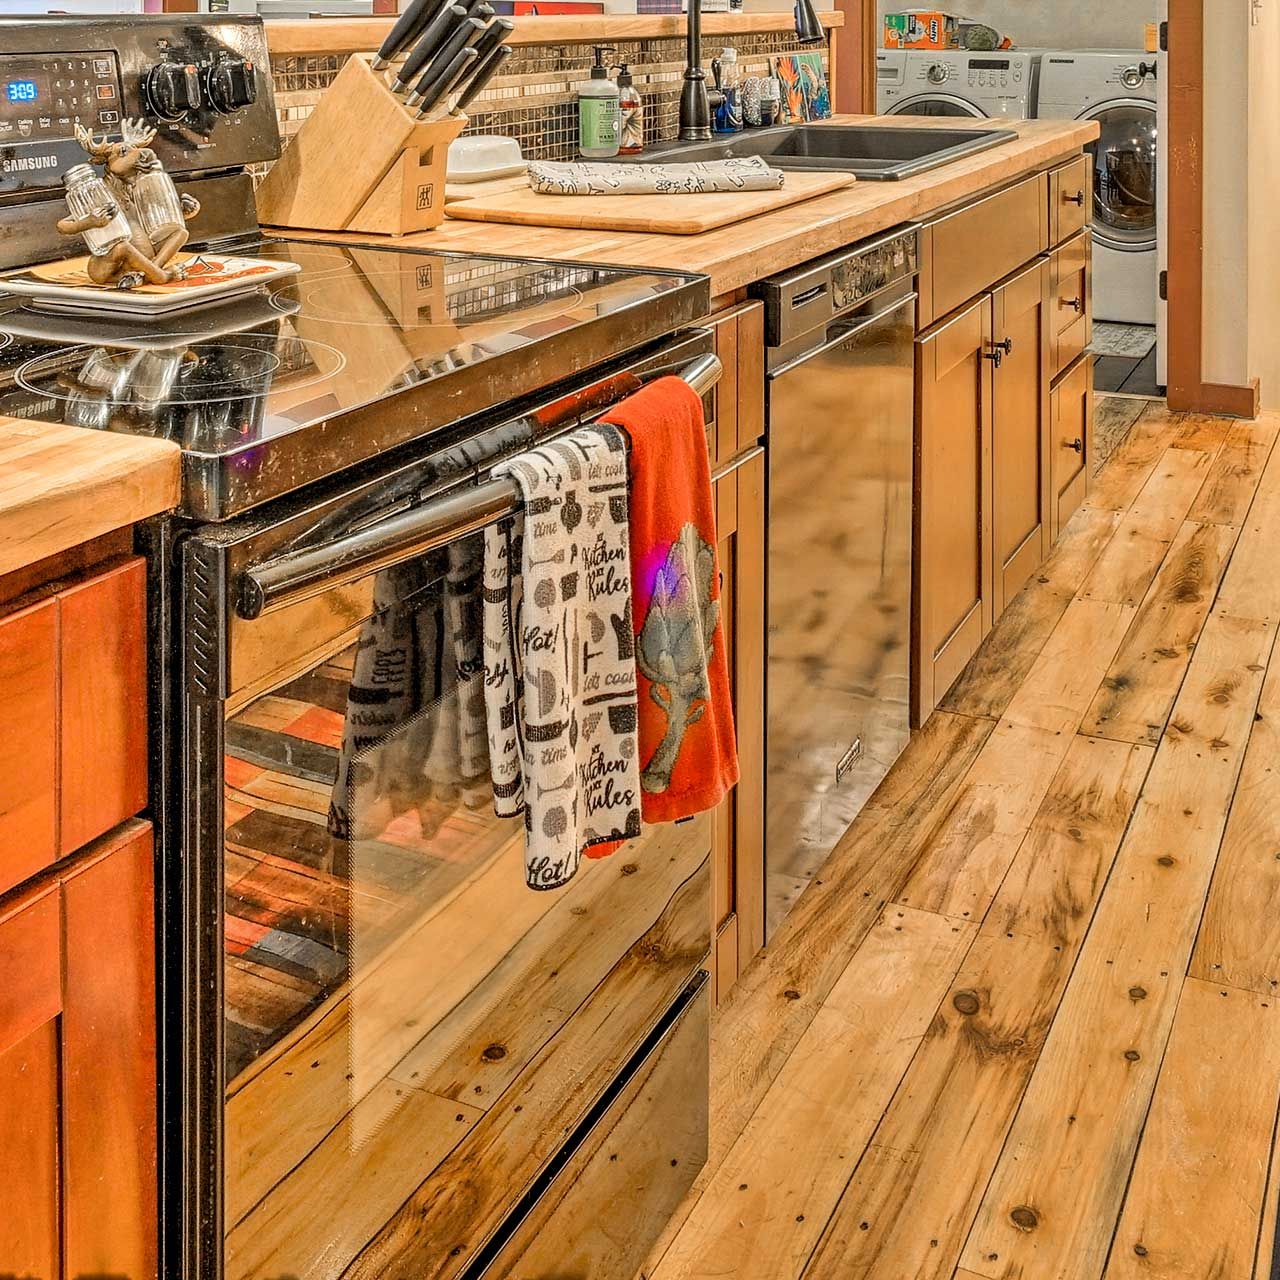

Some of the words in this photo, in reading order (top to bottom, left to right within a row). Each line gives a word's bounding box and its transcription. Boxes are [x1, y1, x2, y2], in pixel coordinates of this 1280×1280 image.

[2, 155, 58, 172] SAMSUNG
[582, 540, 626, 570] Kitchen
[587, 566, 629, 602] Rules
[523, 623, 560, 656] Hot!
[579, 752, 629, 788] Kitchen
[584, 778, 635, 818] Rules
[527, 851, 571, 885] Hot!
